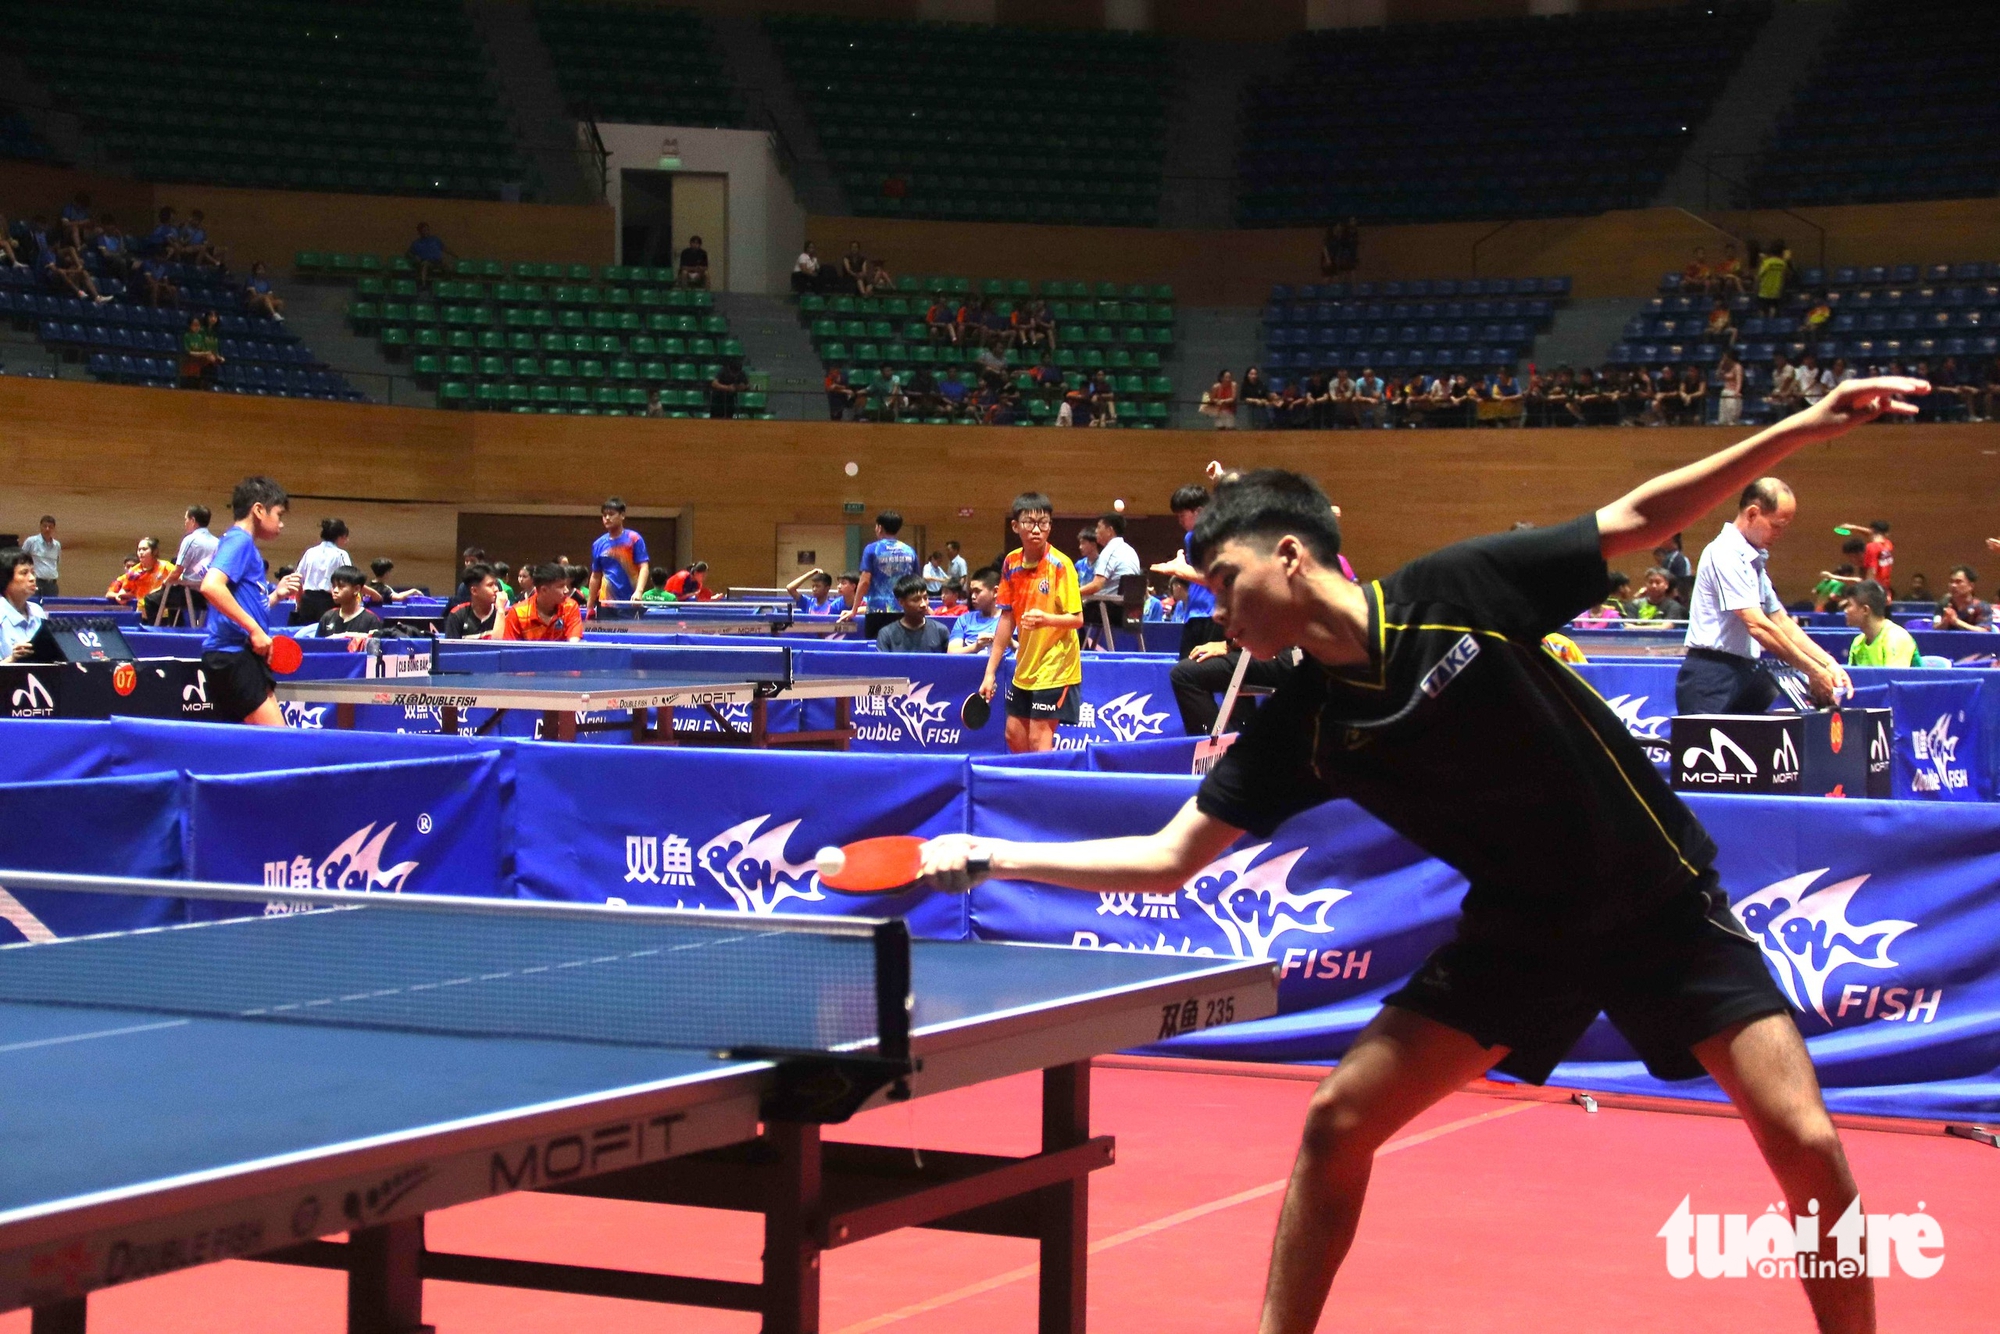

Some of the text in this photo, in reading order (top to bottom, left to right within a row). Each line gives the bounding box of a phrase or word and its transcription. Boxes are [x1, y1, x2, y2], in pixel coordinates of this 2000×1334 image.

[78, 631, 102, 647] 02
[117, 670, 135, 688] 07
[883, 685, 895, 695] 235
[418, 693, 455, 706] DOUBLE
[456, 696, 477, 706] FISH
[691, 692, 736, 704] MOFIT
[12, 708, 54, 717] MOFIT
[182, 702, 213, 712] MOFI
[1031, 702, 1056, 711] XIOM
[926, 728, 960, 744] FISH
[1871, 761, 1890, 773] MOFIT
[1682, 772, 1758, 784] MOFIT
[1772, 771, 1799, 784] MOFIT
[624, 833, 696, 887] 双魚
[1281, 948, 1372, 980] FISH
[1836, 983, 1943, 1023] FISH
[1205, 996, 1235, 1028] 235
[489, 1112, 686, 1194] MOFIT
